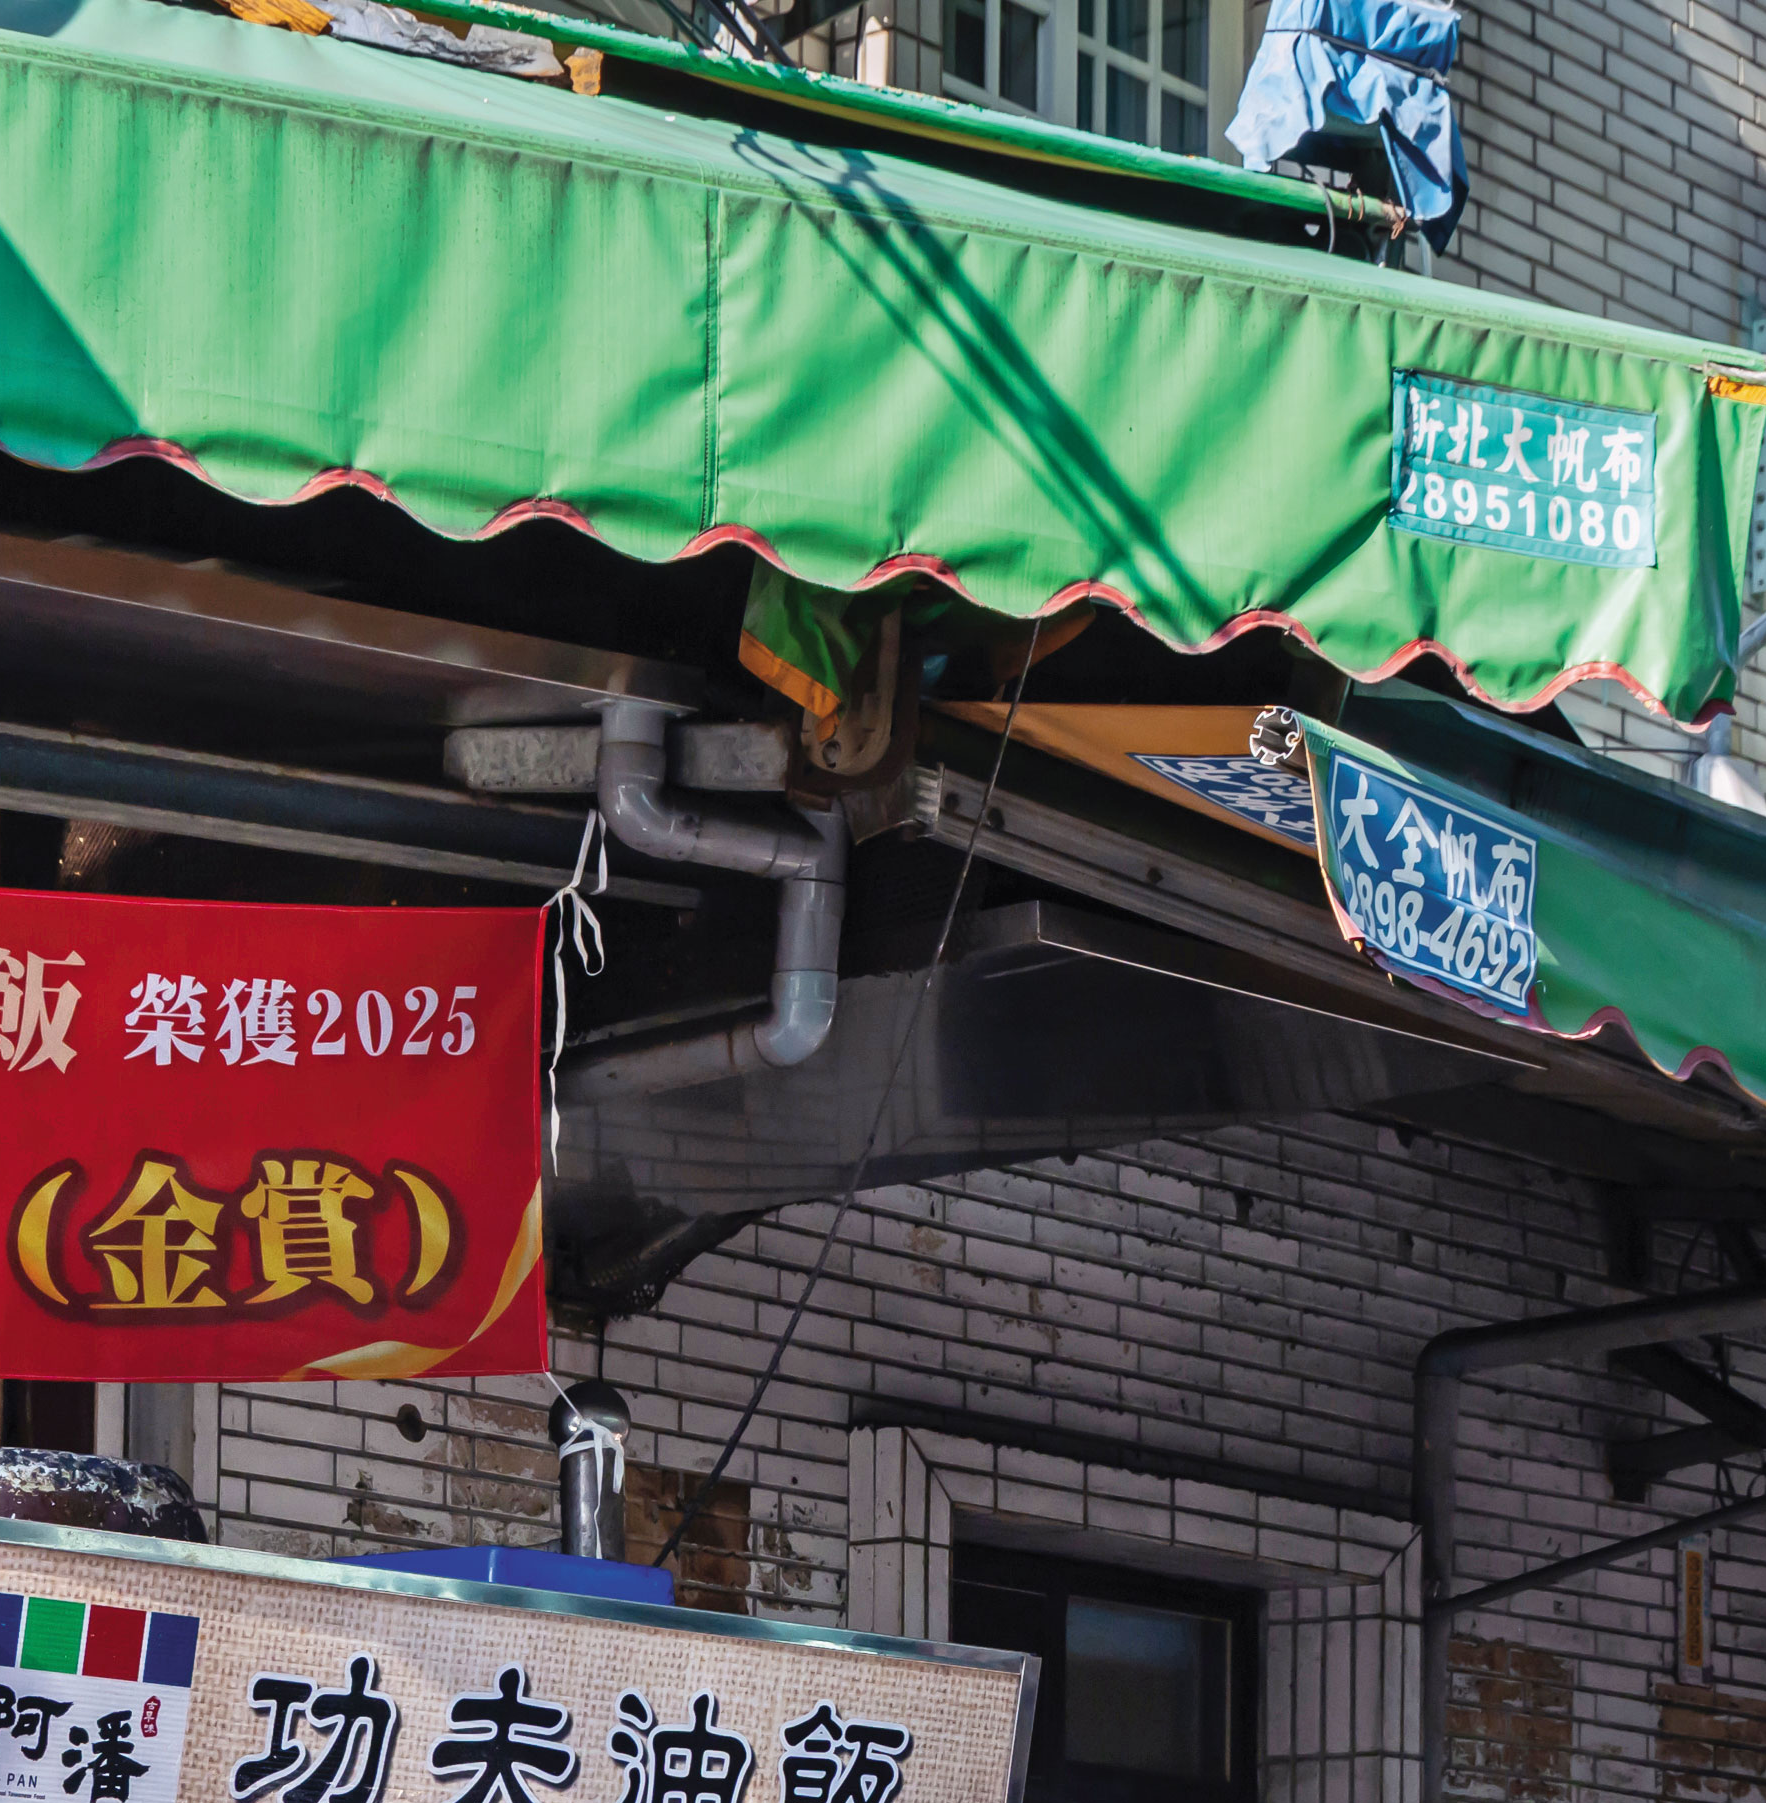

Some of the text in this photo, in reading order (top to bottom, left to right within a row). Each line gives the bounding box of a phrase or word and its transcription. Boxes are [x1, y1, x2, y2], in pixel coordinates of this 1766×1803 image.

[1409, 386, 1644, 499] 新北大帆布
[1398, 465, 1641, 550] 28951080
[1339, 772, 1530, 930] 大全帆布
[1343, 863, 1529, 997] 2898-4692
[124, 971, 478, 1067] 榮獲2025
